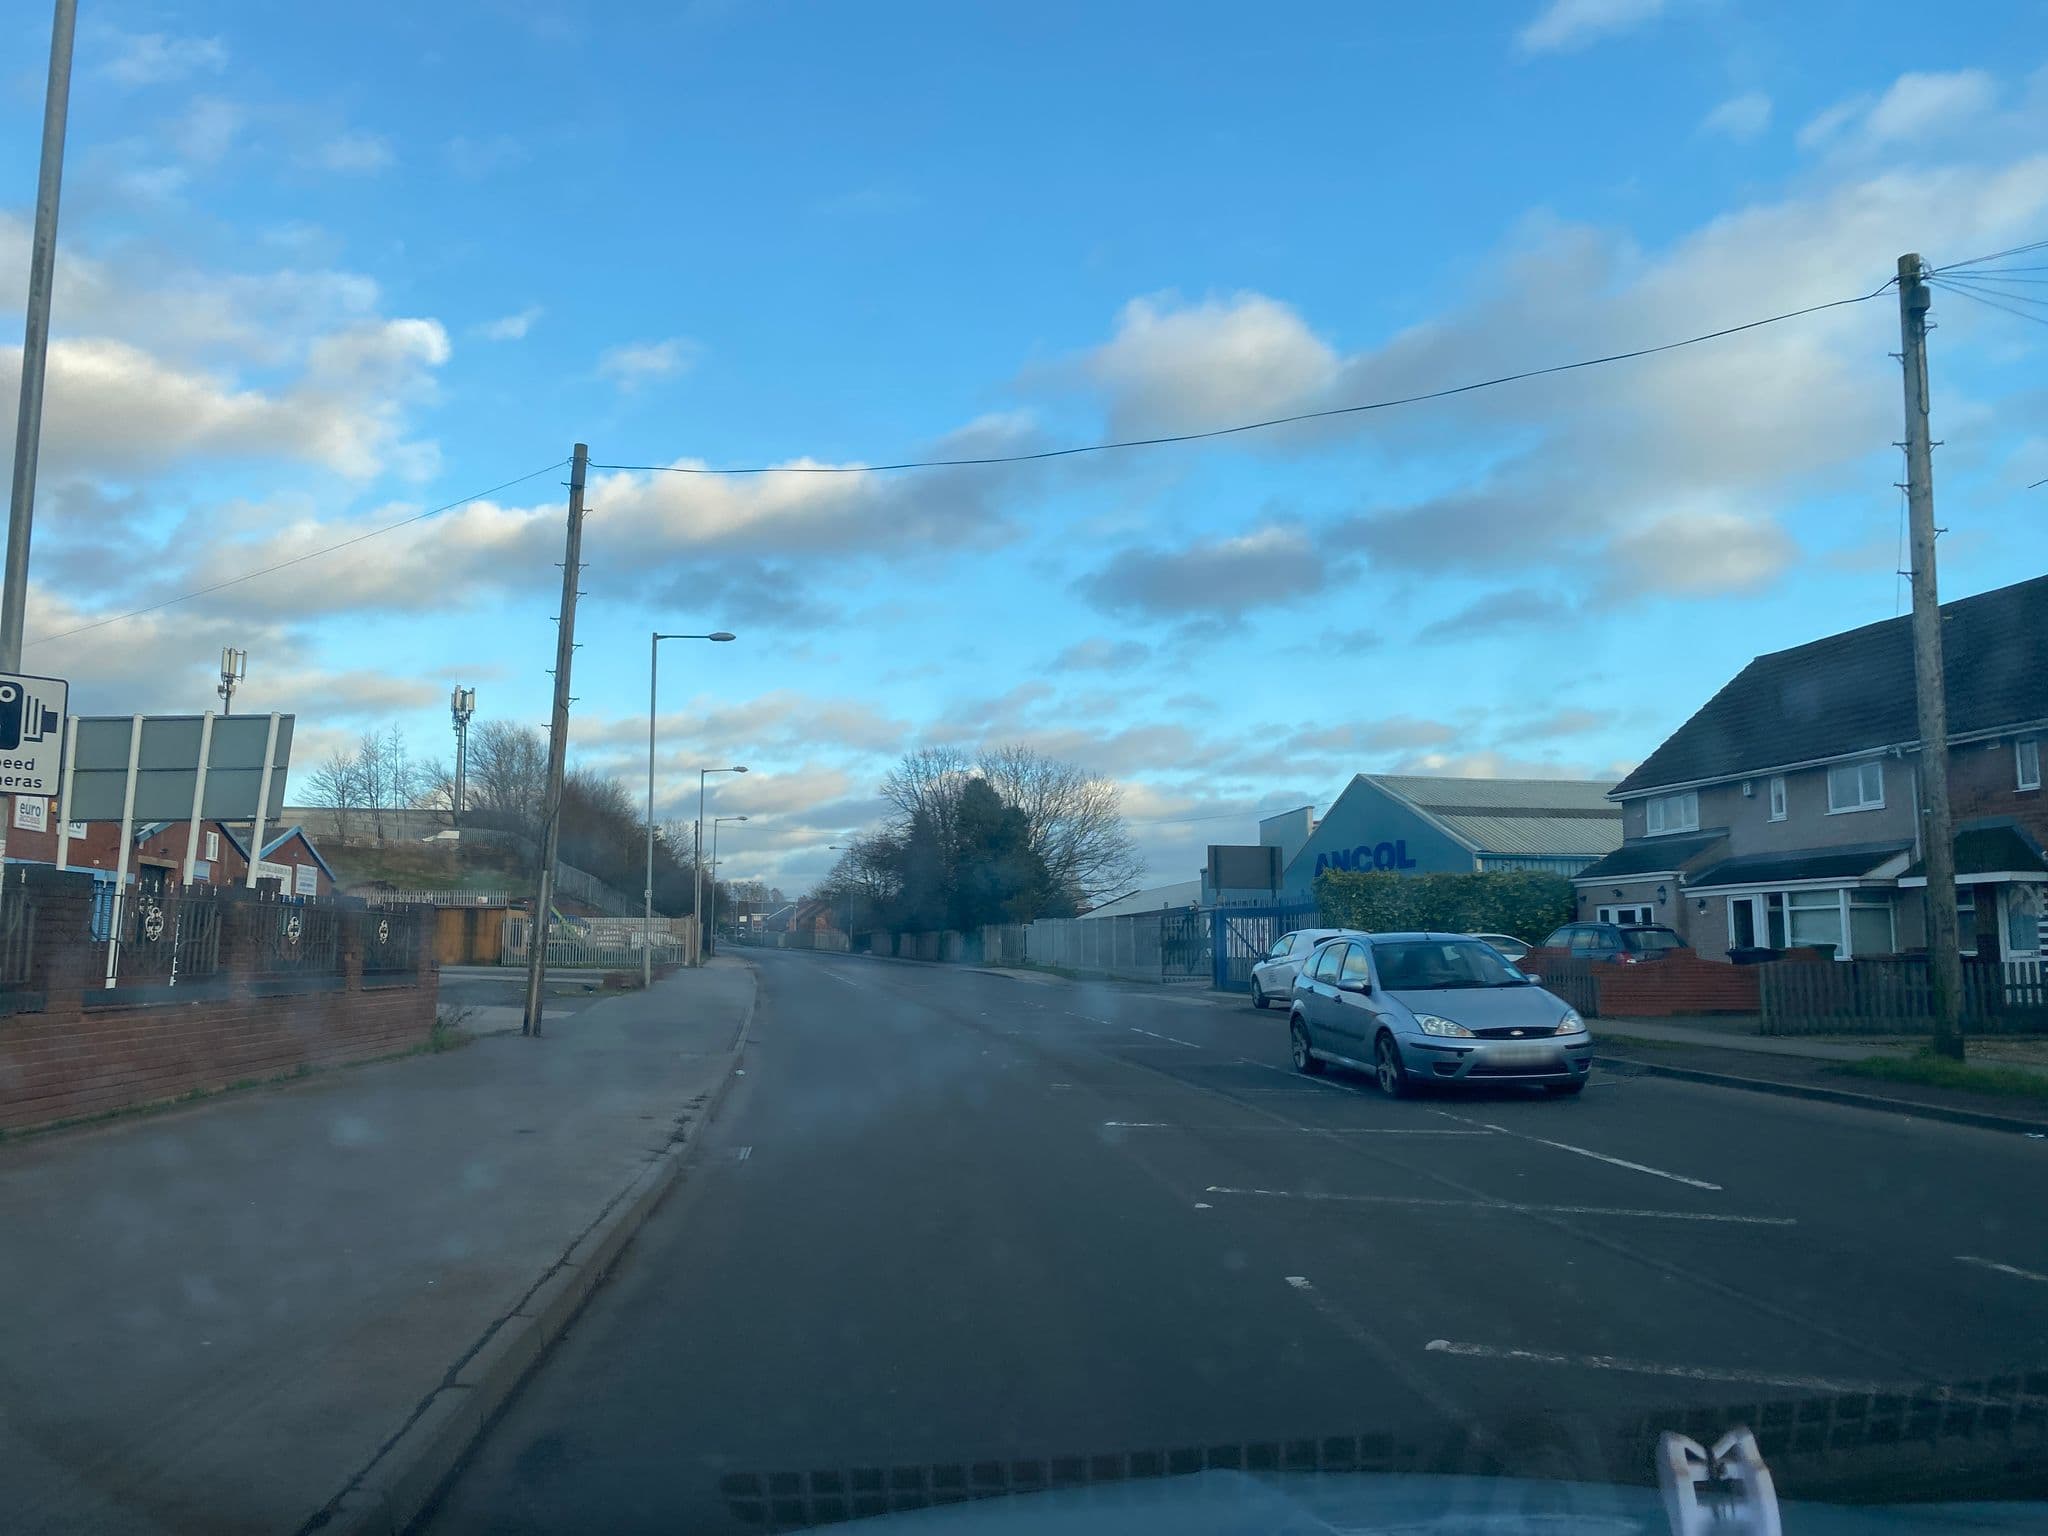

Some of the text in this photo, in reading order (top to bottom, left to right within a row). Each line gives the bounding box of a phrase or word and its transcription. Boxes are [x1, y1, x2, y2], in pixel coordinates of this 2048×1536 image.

[0, 758, 35, 771] eed
[0, 776, 42, 788] eras
[19, 802, 41, 817] euro
[1315, 840, 1416, 877] ANCOL
